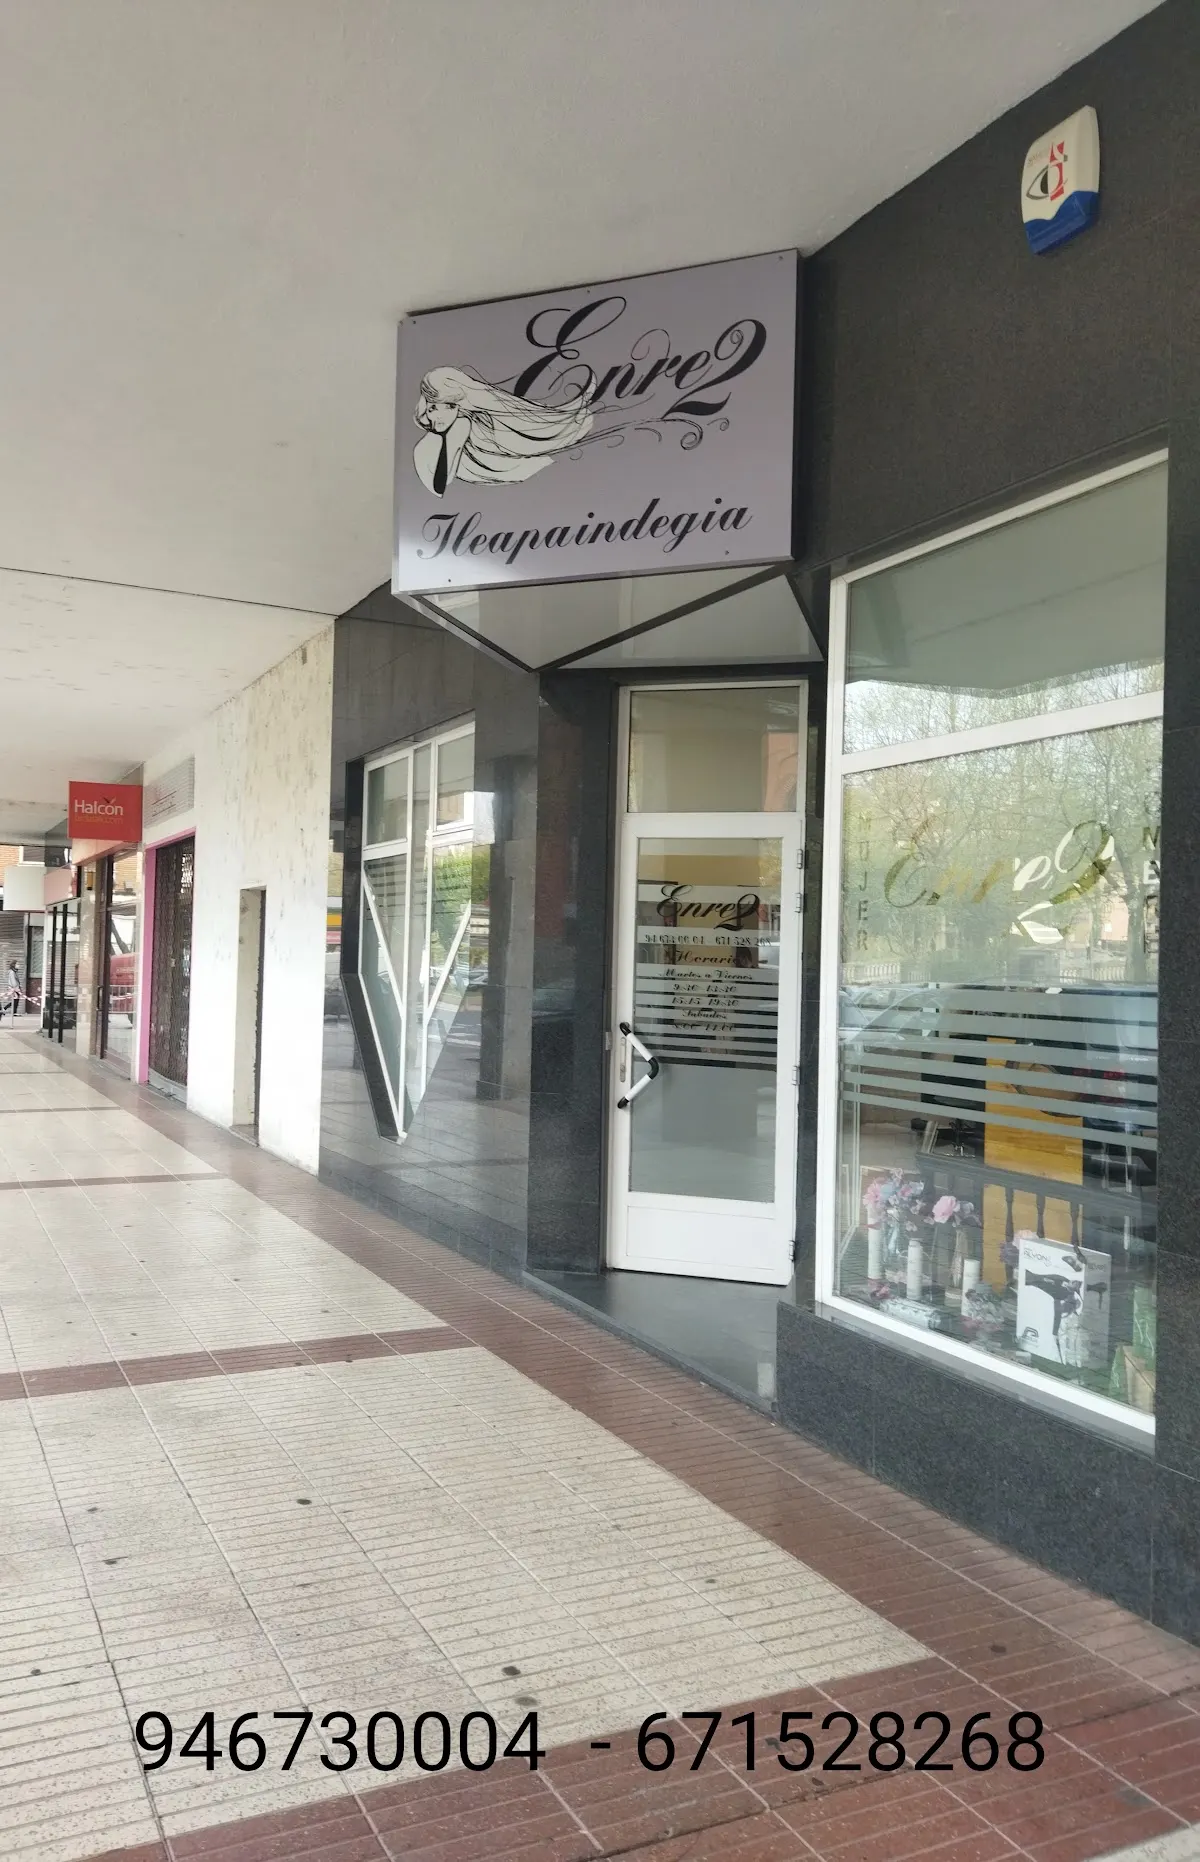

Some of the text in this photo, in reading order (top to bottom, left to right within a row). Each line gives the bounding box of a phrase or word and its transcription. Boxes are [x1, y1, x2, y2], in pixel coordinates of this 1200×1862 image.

[512, 295, 768, 420] Enre2
[416, 497, 753, 565] Ileapaindegia
[656, 884, 760, 932] Enre2
